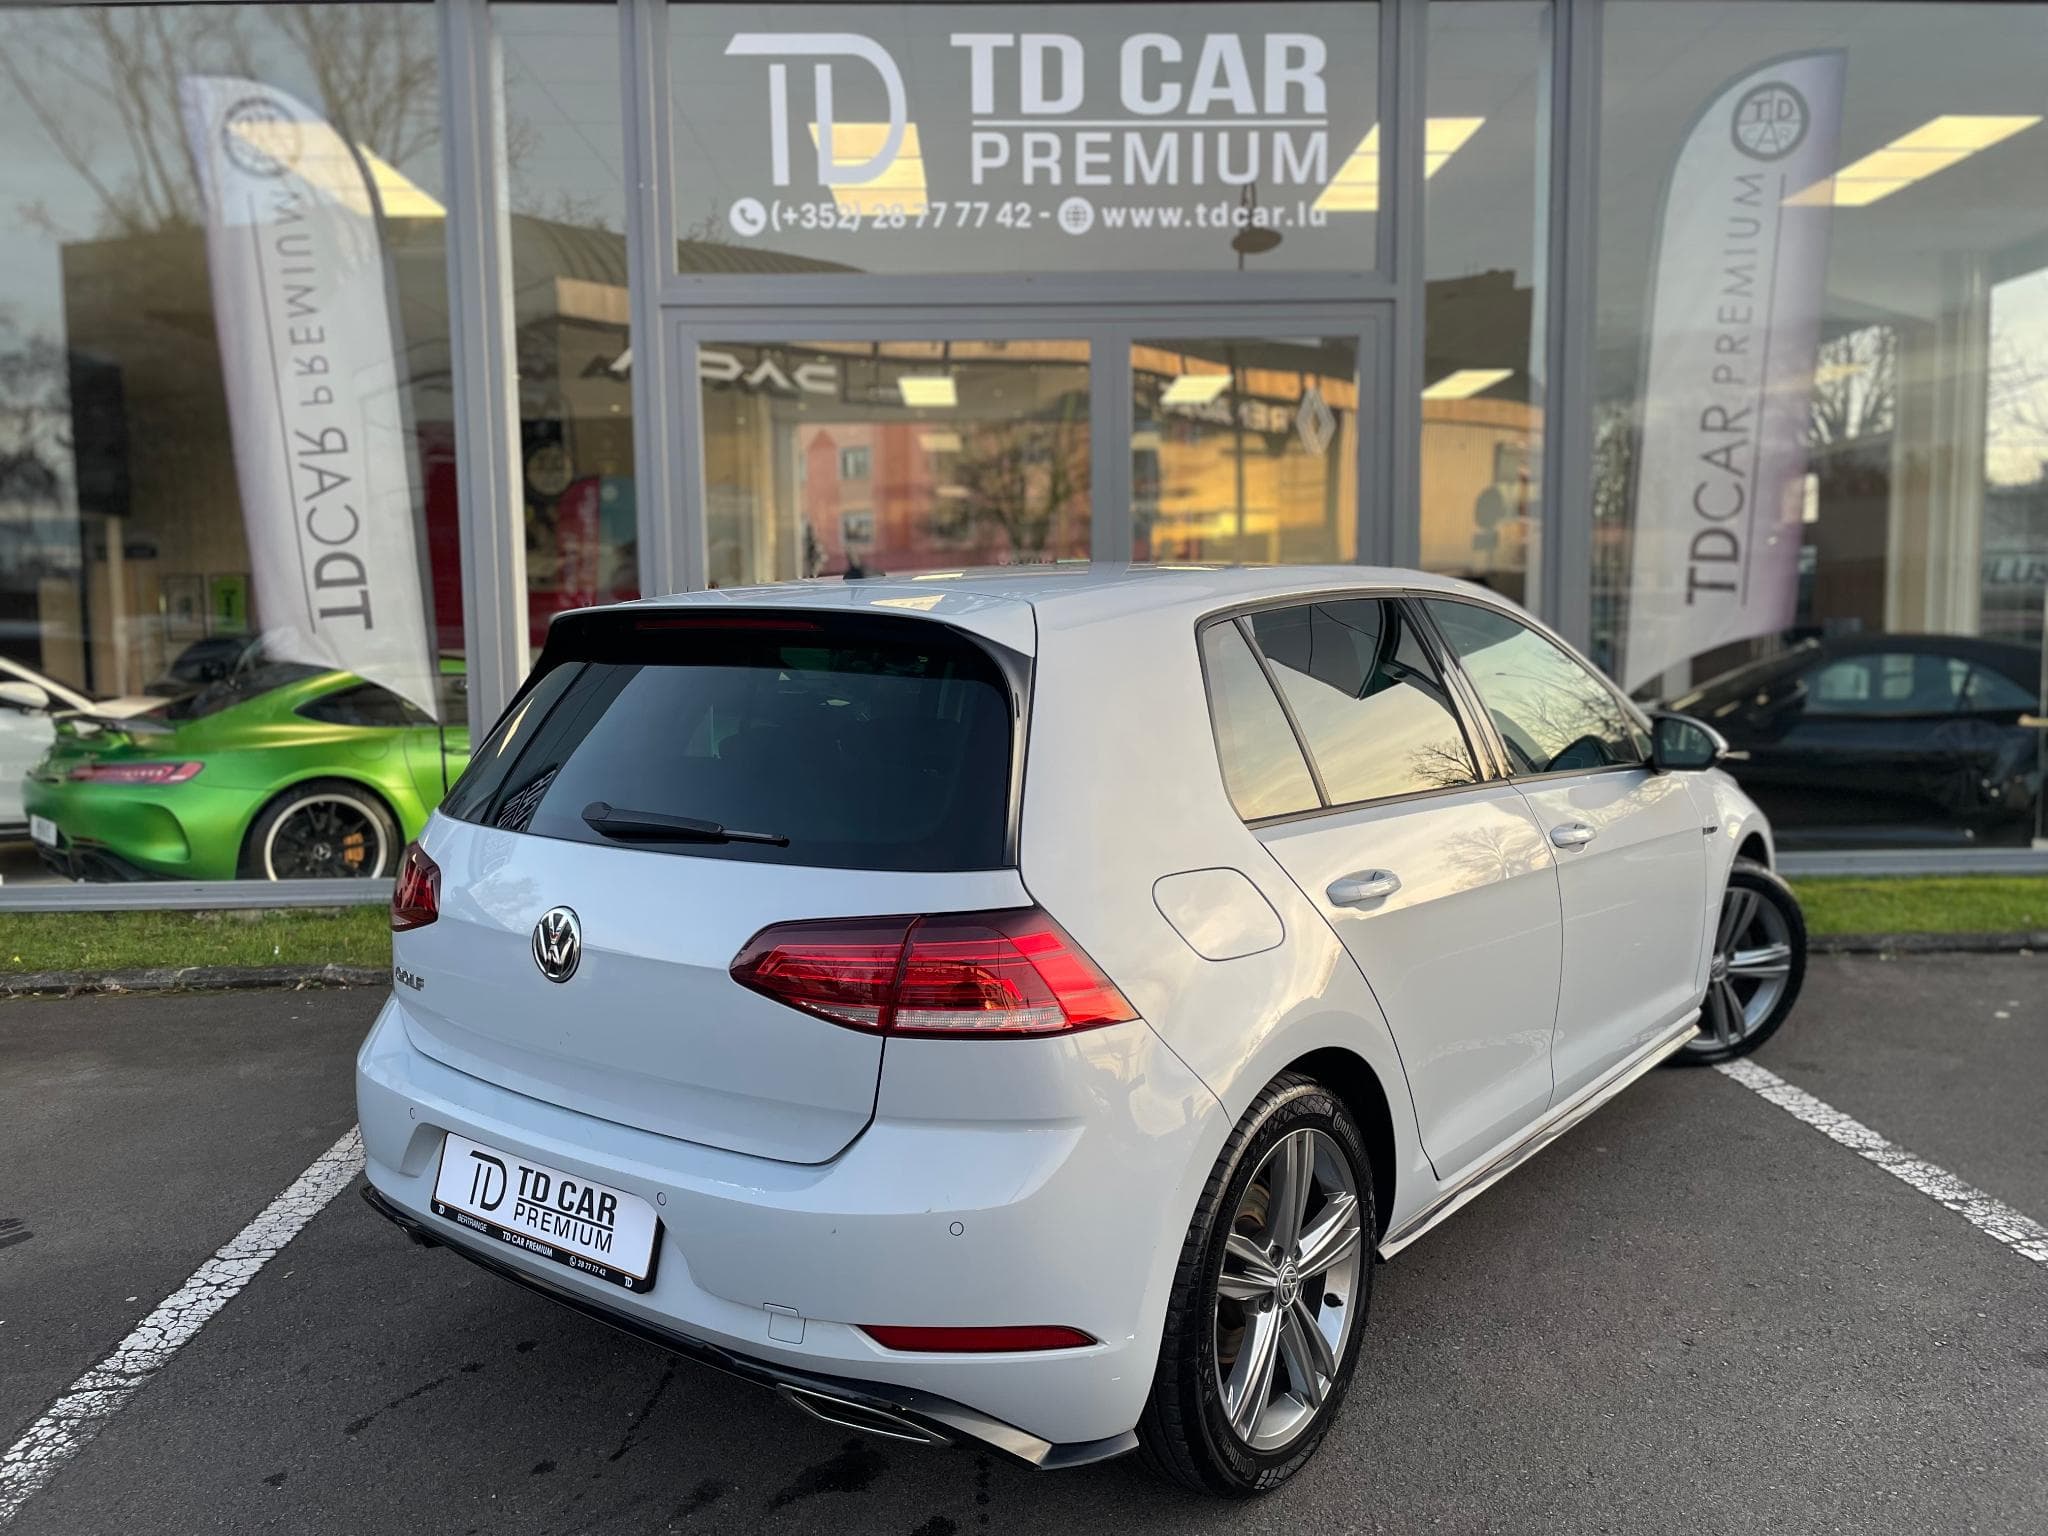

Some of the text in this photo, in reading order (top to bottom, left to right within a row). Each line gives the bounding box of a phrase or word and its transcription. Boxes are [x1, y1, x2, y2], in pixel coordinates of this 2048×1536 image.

[951, 33, 1328, 115] TD CAR
[972, 131, 1328, 185] PREMIUM
[771, 200, 861, 232] (+352)
[872, 203, 907, 229] 28
[914, 202, 948, 229] 77
[954, 201, 990, 229] 77
[995, 202, 1032, 229] 42
[1101, 200, 1328, 229] www.tdcar.lu
[1685, 172, 1765, 606] TDCAR PREMIUM
[395, 966, 425, 992] GOLF
[518, 1165, 618, 1227] TD CAR
[457, 1213, 487, 1233] BERTRANGE
[502, 1230, 553, 1258] TD CAR PREMIUM
[513, 1202, 614, 1254] PREMIUM
